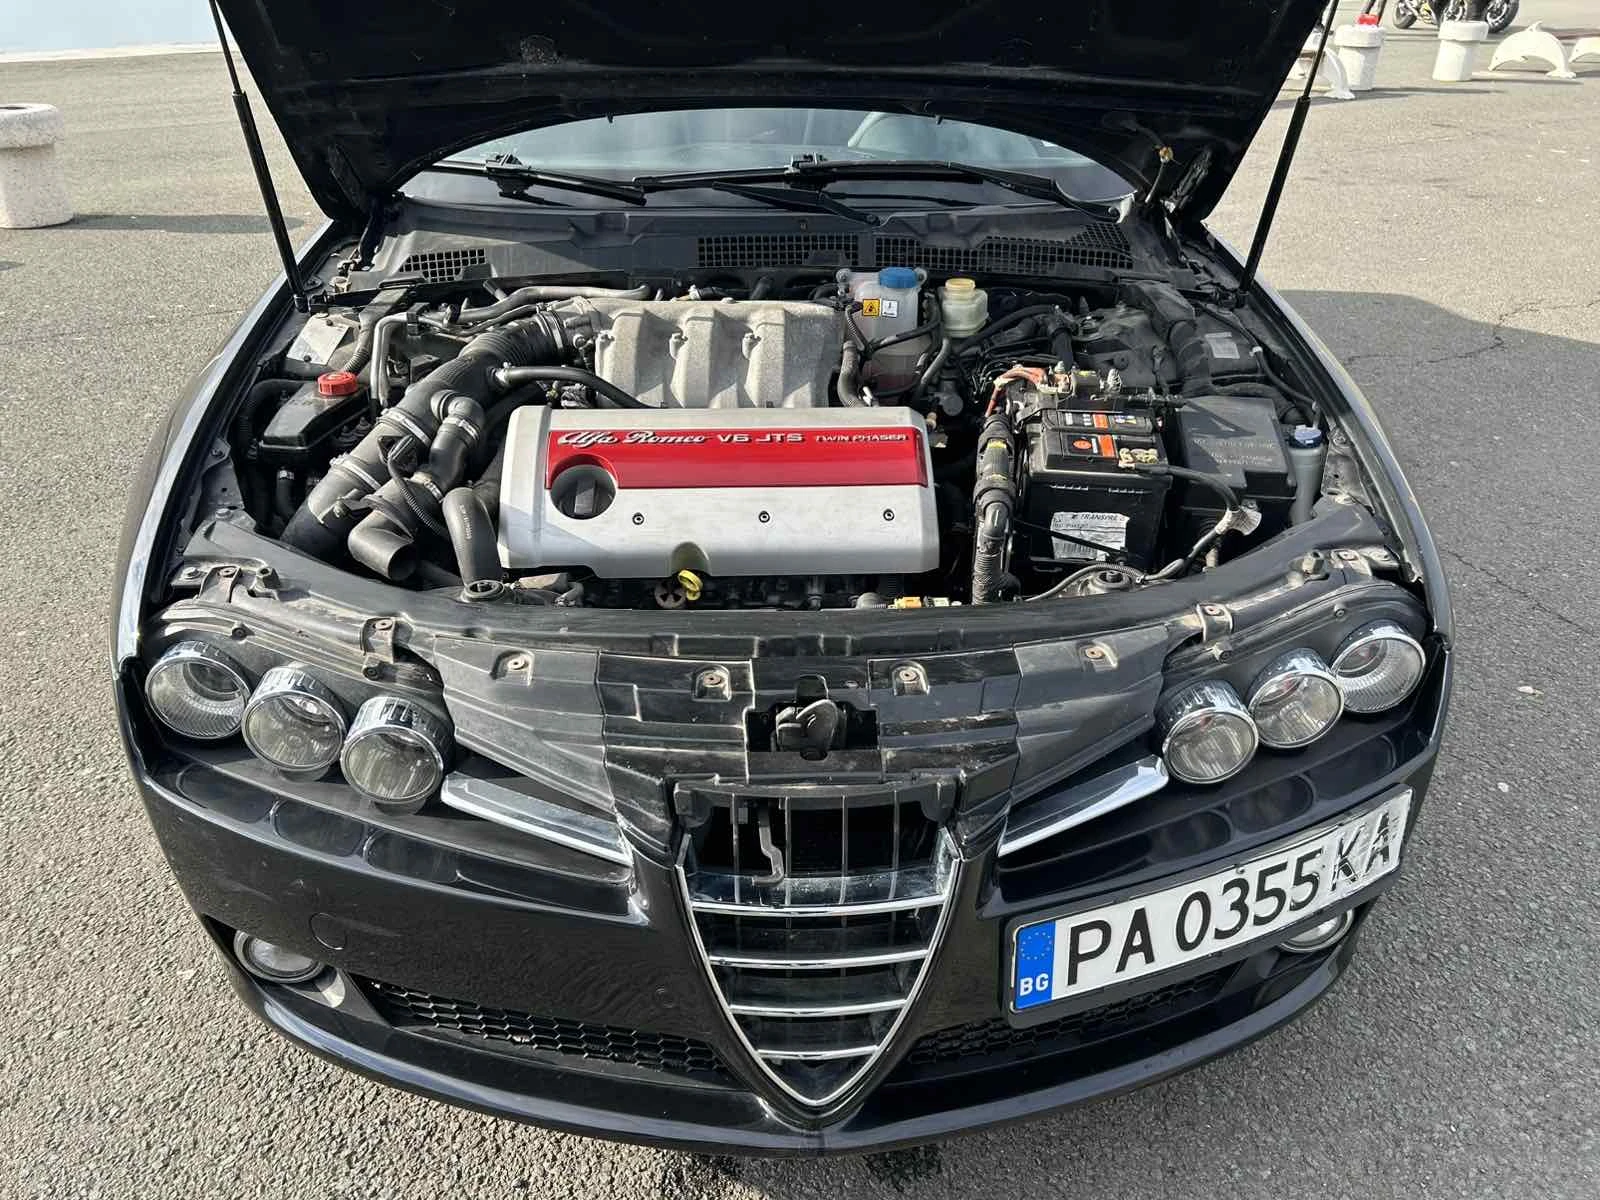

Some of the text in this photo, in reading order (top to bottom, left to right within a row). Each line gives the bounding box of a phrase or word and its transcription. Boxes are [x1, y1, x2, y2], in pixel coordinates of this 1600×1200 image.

[557, 430, 907, 448] Alfa Romeo V6 JTS TWIN PHASER
[1066, 907, 1156, 986] PA
[1174, 852, 1324, 952] 0355
[1019, 973, 1050, 997] BG
